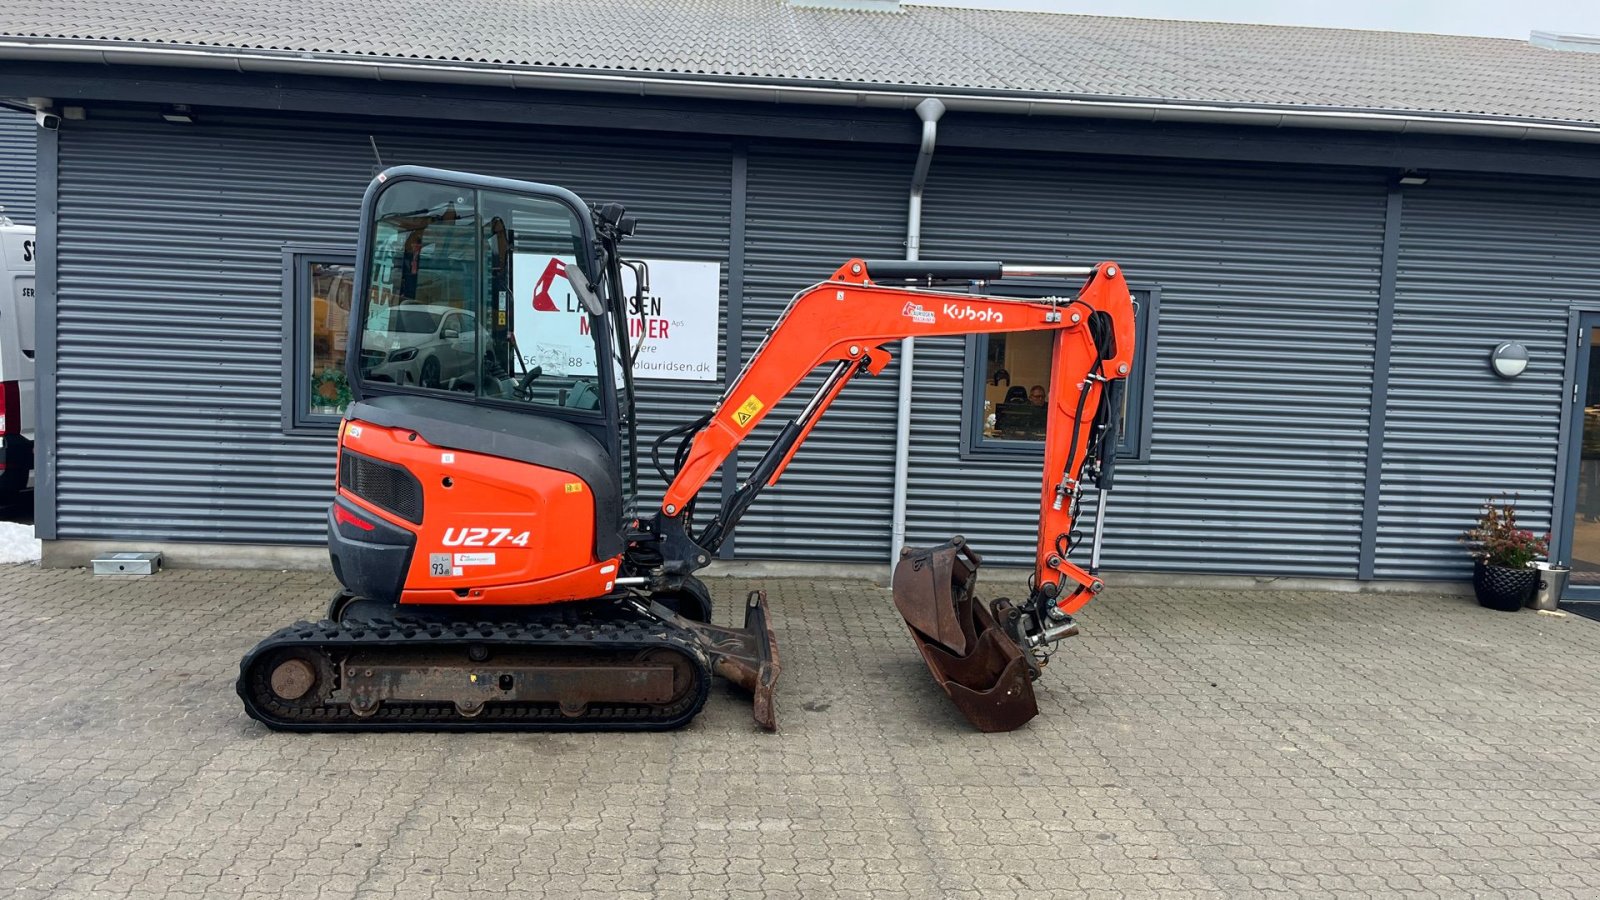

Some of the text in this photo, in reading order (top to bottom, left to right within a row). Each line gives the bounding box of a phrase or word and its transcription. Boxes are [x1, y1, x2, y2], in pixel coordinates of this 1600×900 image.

[22, 288, 35, 297] SER
[943, 304, 1003, 323] Kubota
[442, 528, 530, 546] U27-4
[432, 563, 444, 575] 93
